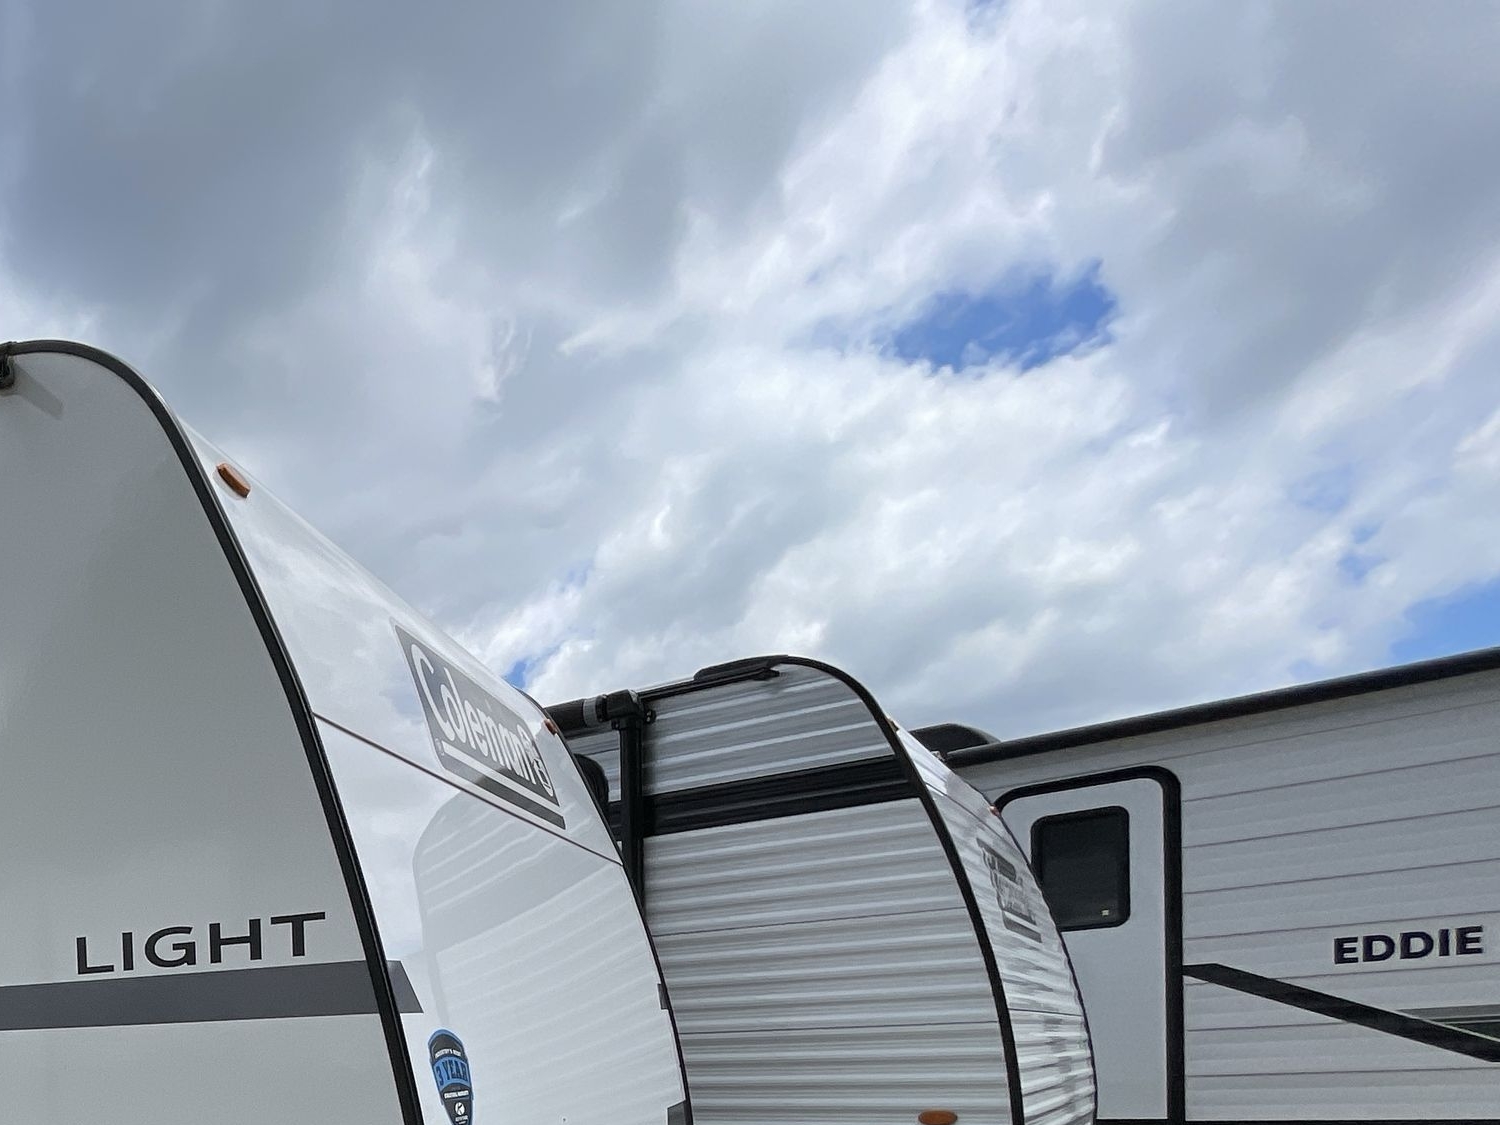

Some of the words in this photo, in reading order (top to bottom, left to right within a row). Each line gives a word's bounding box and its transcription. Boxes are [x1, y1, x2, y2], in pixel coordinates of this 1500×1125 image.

[411, 644, 537, 784] Coleman
[76, 911, 326, 975] LIGHT
[1333, 925, 1484, 965] EDDIE
[442, 1059, 469, 1082] YEAR
